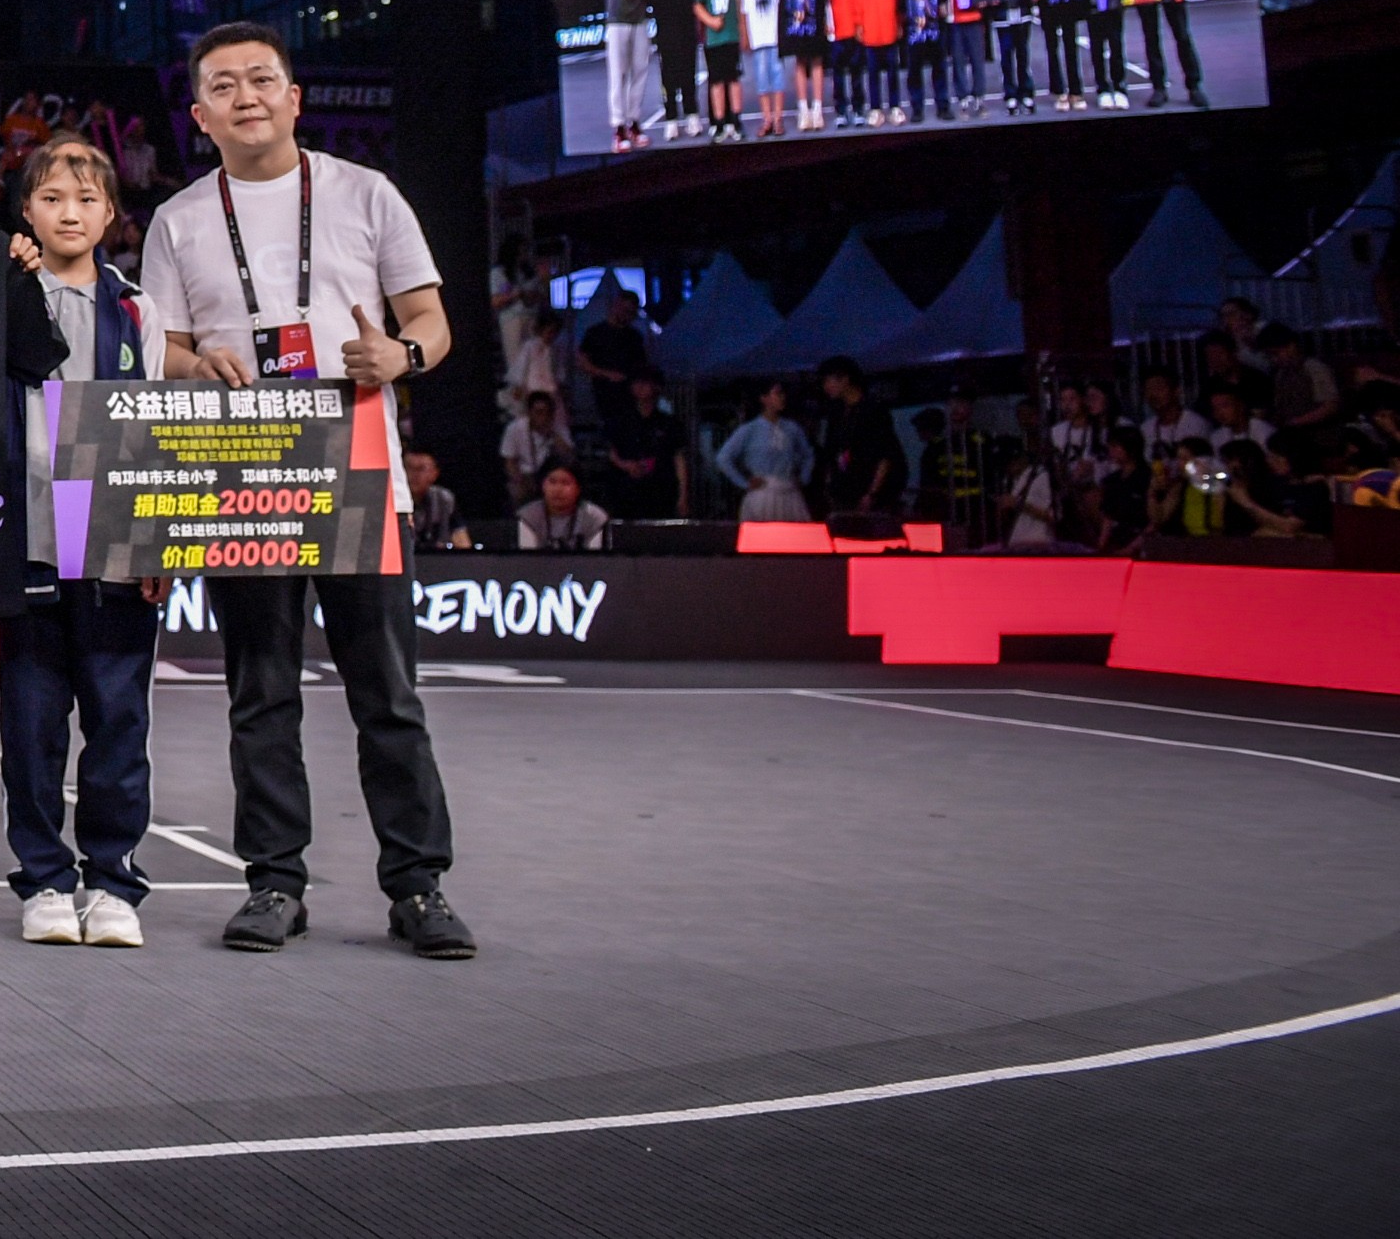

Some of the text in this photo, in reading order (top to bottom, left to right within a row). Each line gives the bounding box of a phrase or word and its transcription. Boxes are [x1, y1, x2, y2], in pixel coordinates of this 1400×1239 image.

[106, 388, 343, 420] 公益捐赠 赋能校园
[133, 488, 334, 517] 捐助现金20000元
[161, 540, 320, 569] 价值60000元
